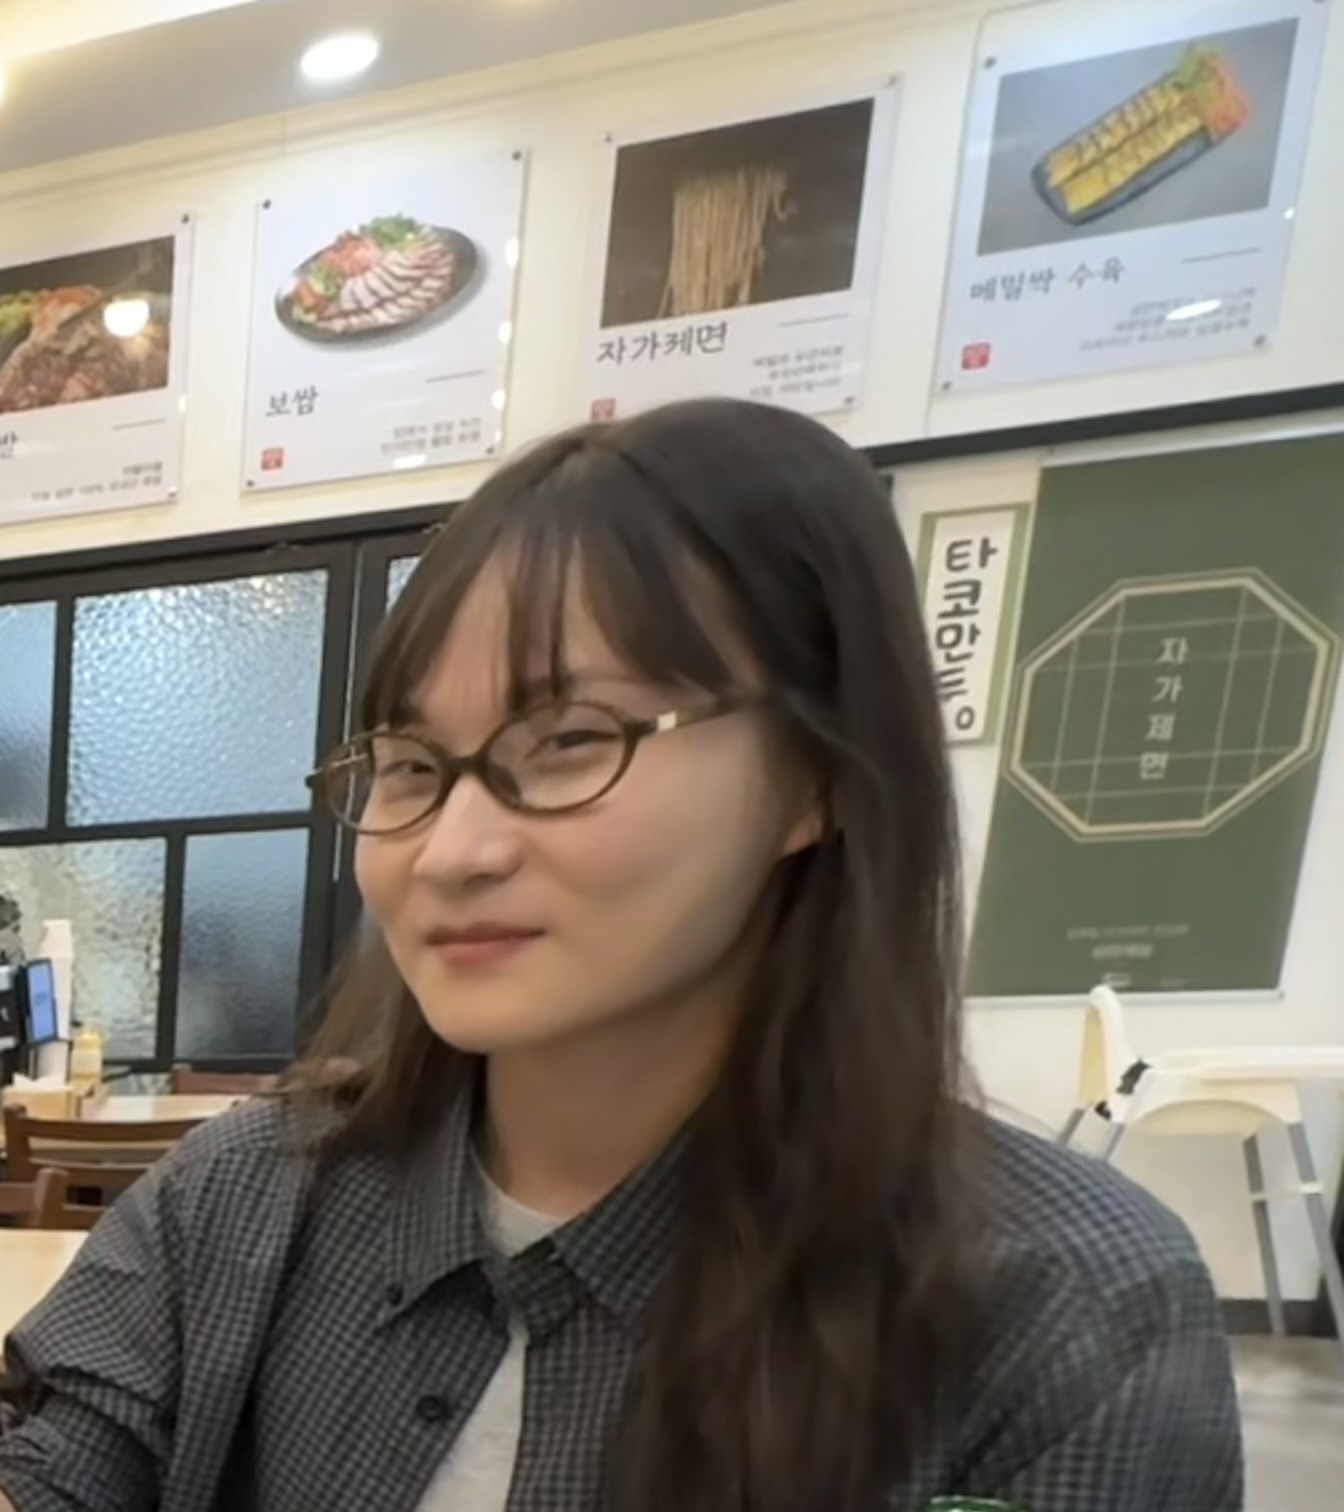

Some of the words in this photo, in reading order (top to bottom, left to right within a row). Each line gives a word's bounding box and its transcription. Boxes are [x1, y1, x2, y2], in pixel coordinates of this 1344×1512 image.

[1067, 256, 1126, 290] 수육
[264, 384, 320, 418] 보쌈
[1140, 636, 1189, 780] 자가제면
